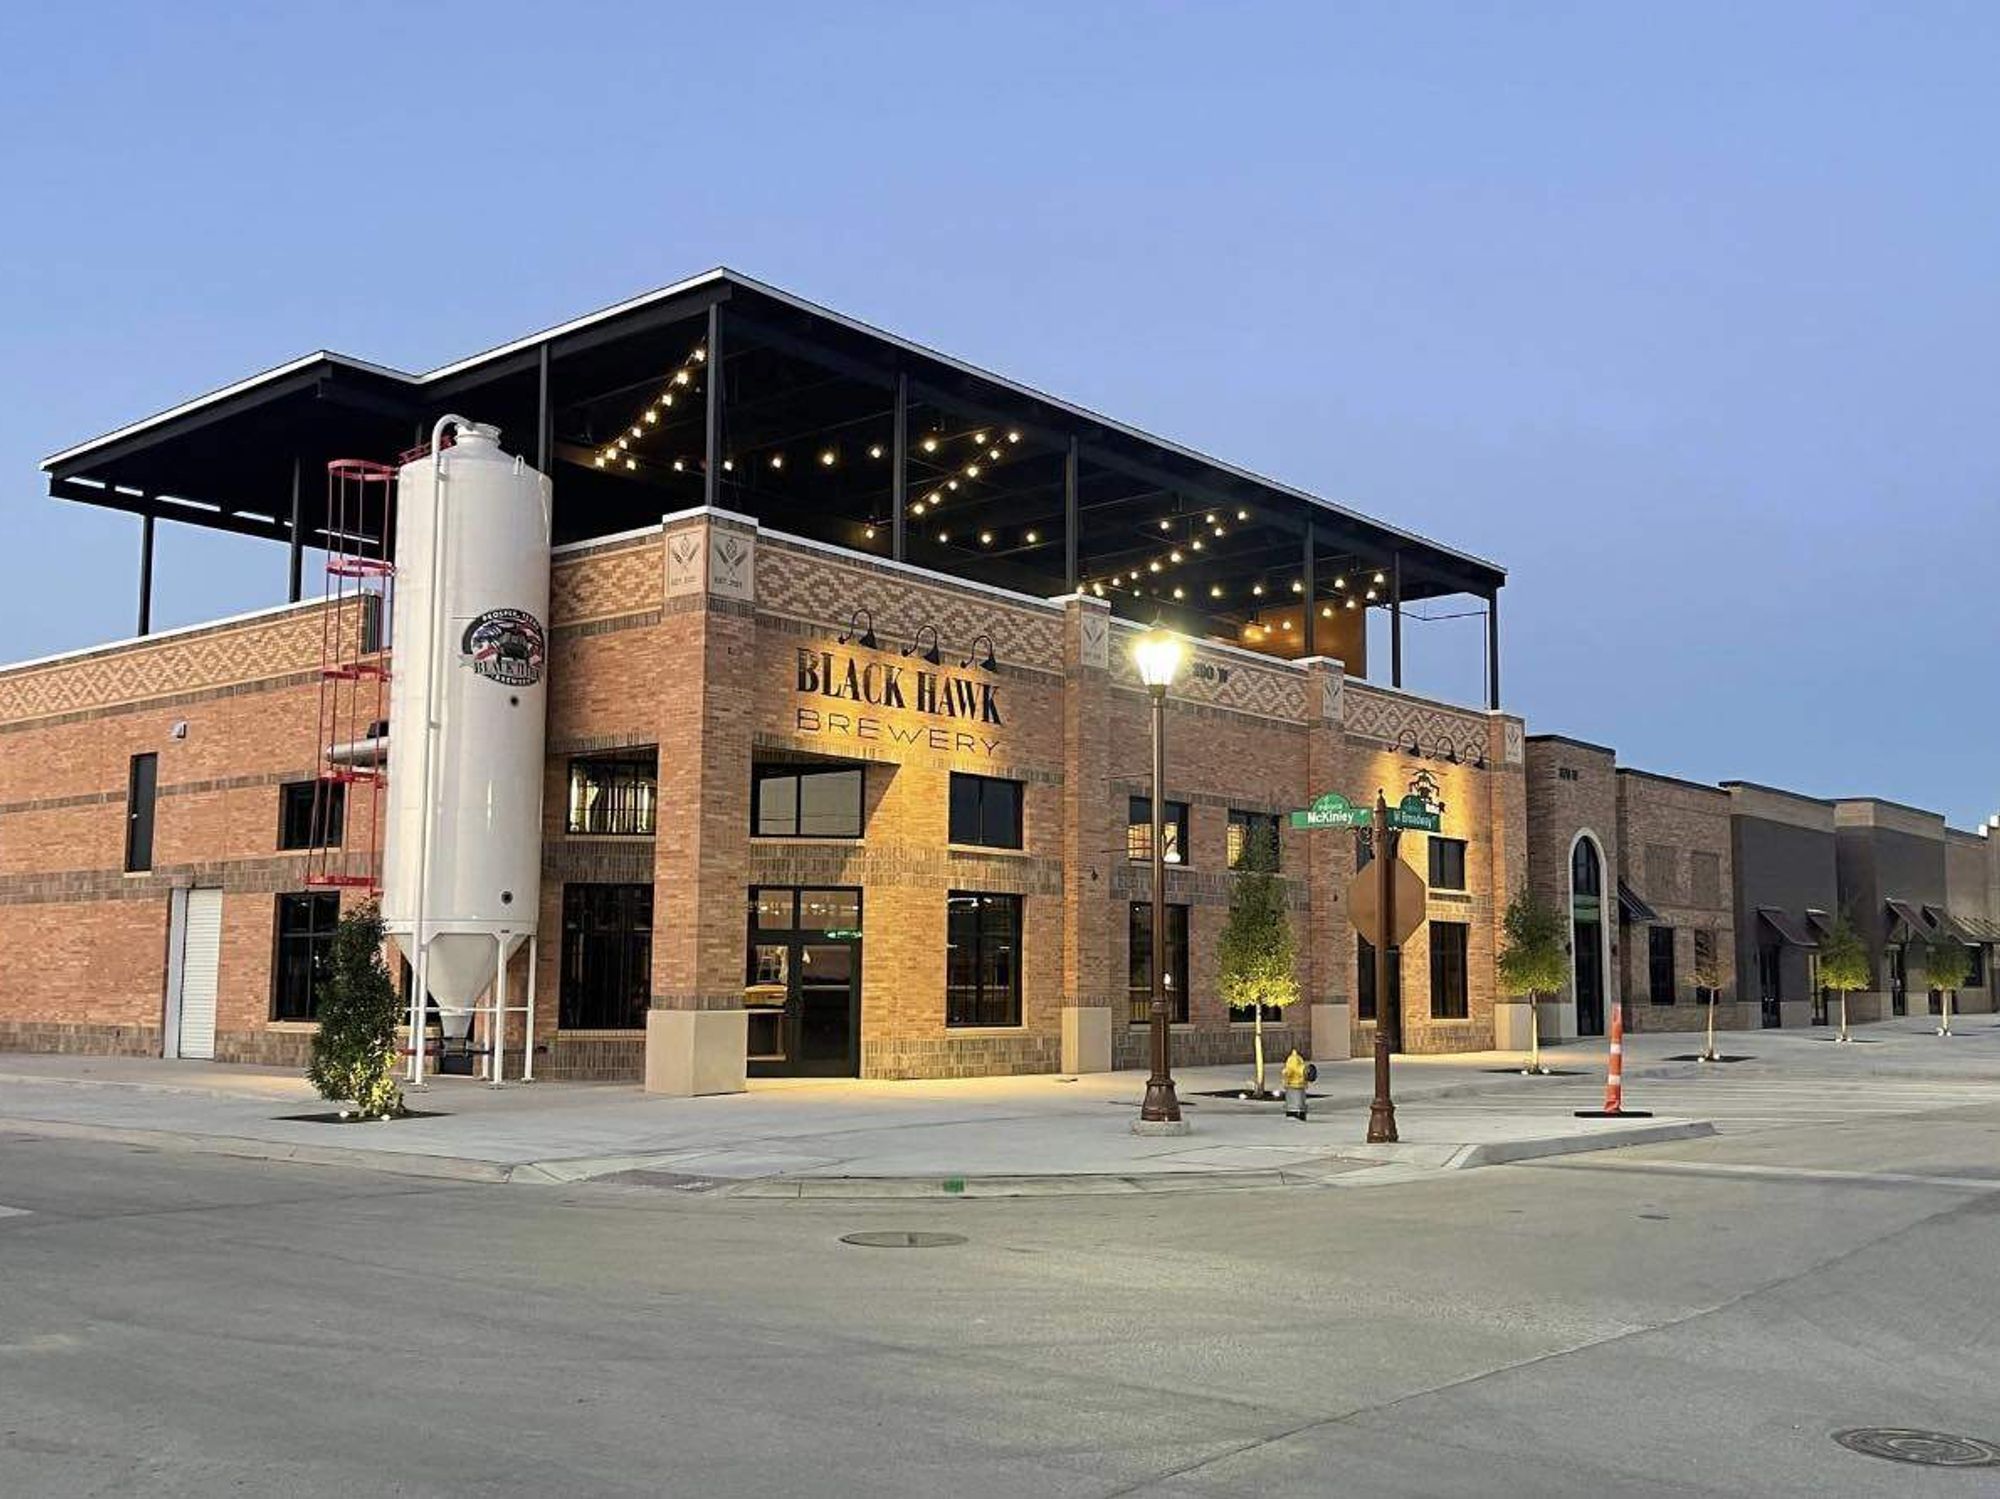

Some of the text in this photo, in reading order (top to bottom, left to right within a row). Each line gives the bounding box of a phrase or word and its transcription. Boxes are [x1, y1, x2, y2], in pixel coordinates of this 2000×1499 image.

[797, 648, 1001, 724] BLACK HAWK
[797, 707, 1000, 757] BREWERY
[1307, 811, 1354, 825] McKinley
[1402, 811, 1431, 829] Broadway
